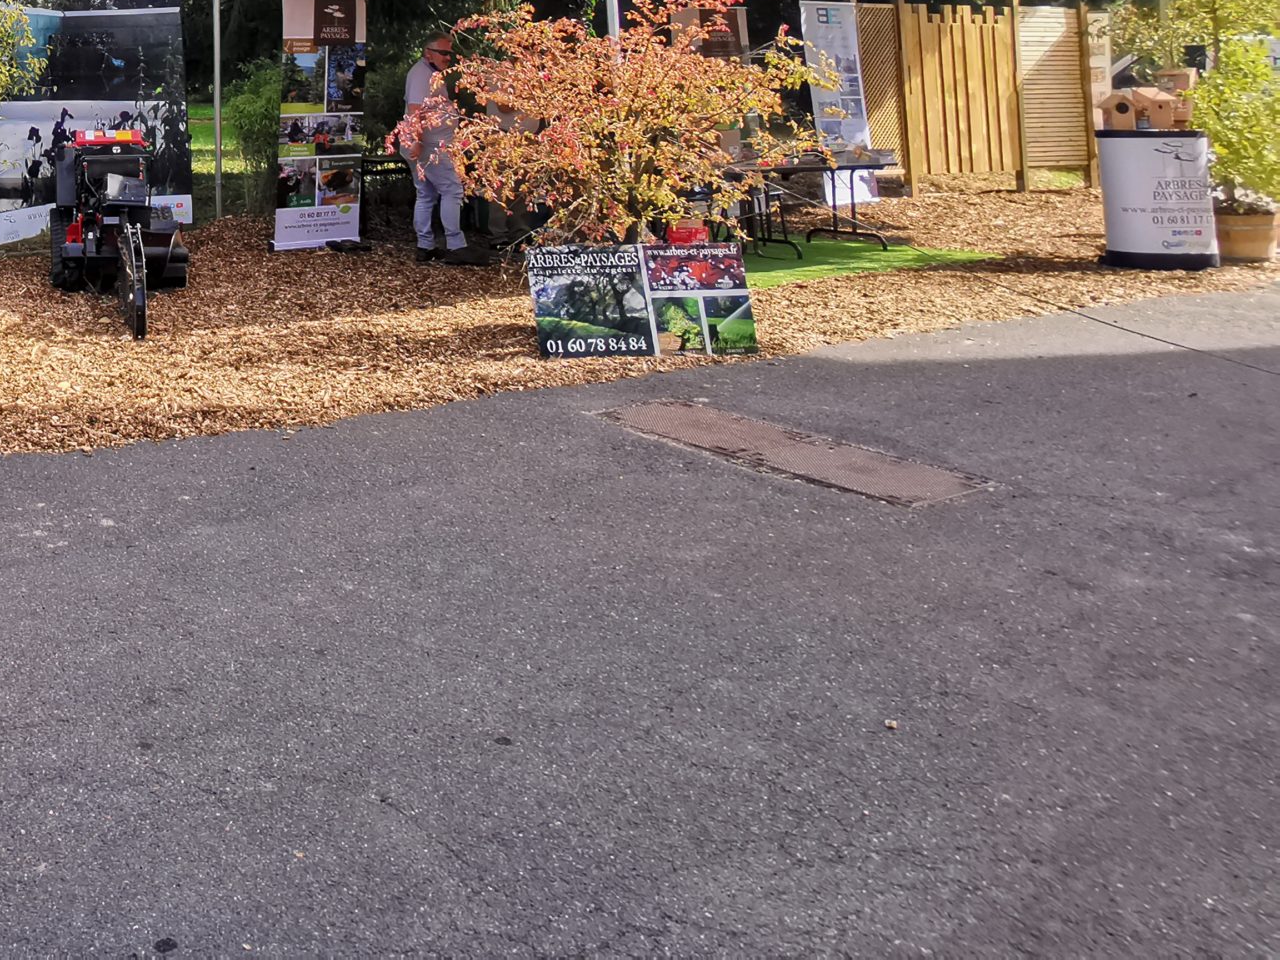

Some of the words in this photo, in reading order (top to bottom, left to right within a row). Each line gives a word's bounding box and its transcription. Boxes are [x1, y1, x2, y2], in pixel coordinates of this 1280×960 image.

[1155, 180, 1202, 190] ARBRES
[1152, 216, 1164, 225] 01
[1167, 216, 1178, 225] 60
[1180, 216, 1190, 224] 81
[646, 245, 737, 258] www.arbres-et-paysages.fr
[533, 267, 543, 275] la
[545, 268, 581, 276] palette
[600, 266, 636, 274] végétal
[546, 339, 564, 353] 01
[567, 338, 586, 352] 60
[587, 338, 606, 352] 78
[608, 337, 627, 351] 84
[629, 336, 648, 350] 84
